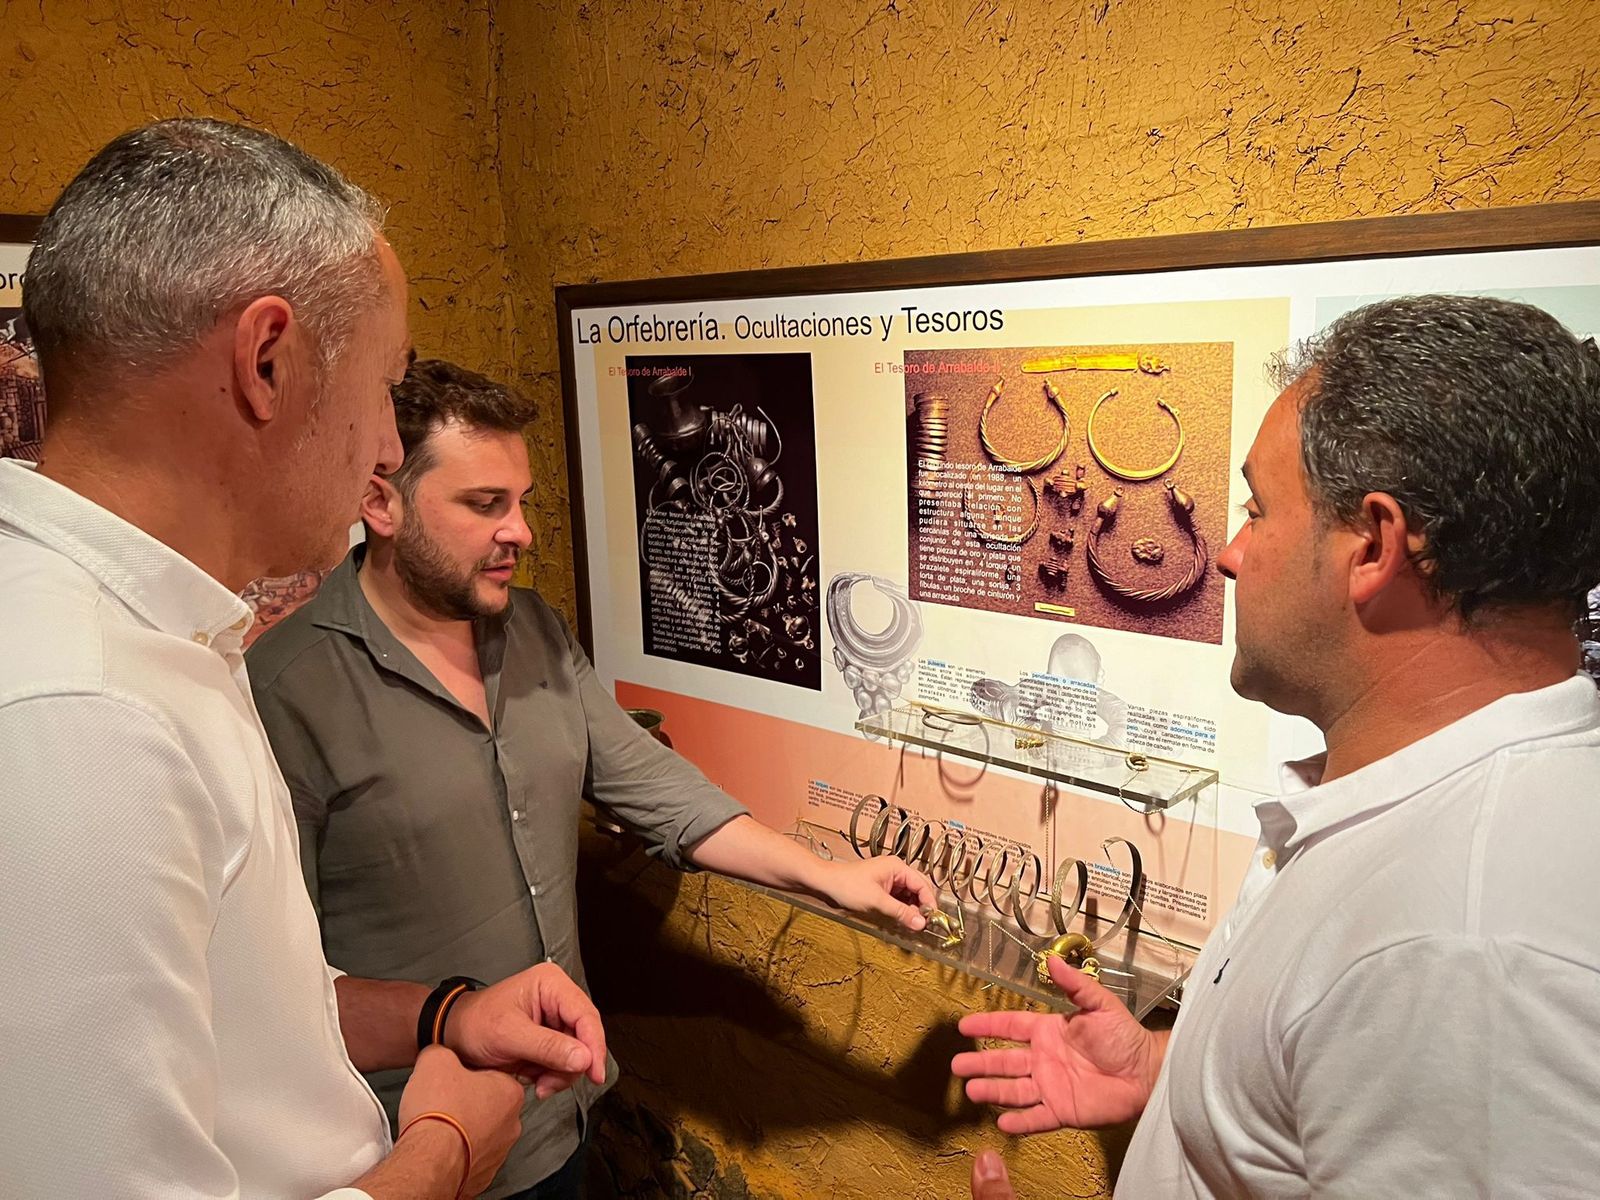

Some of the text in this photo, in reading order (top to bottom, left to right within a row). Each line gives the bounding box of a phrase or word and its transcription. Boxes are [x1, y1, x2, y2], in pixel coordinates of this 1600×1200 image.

[577, 306, 1004, 344] La Orfebrería. Ocultaciones y Tesoros
[608, 367, 616, 376] El
[617, 366, 640, 376] Tesoro
[641, 366, 650, 376] de
[652, 366, 687, 376] Arrabalde
[874, 362, 884, 374] El
[887, 362, 920, 374] Tesoro
[922, 362, 935, 373] de
[938, 361, 994, 373] Arrabalde
